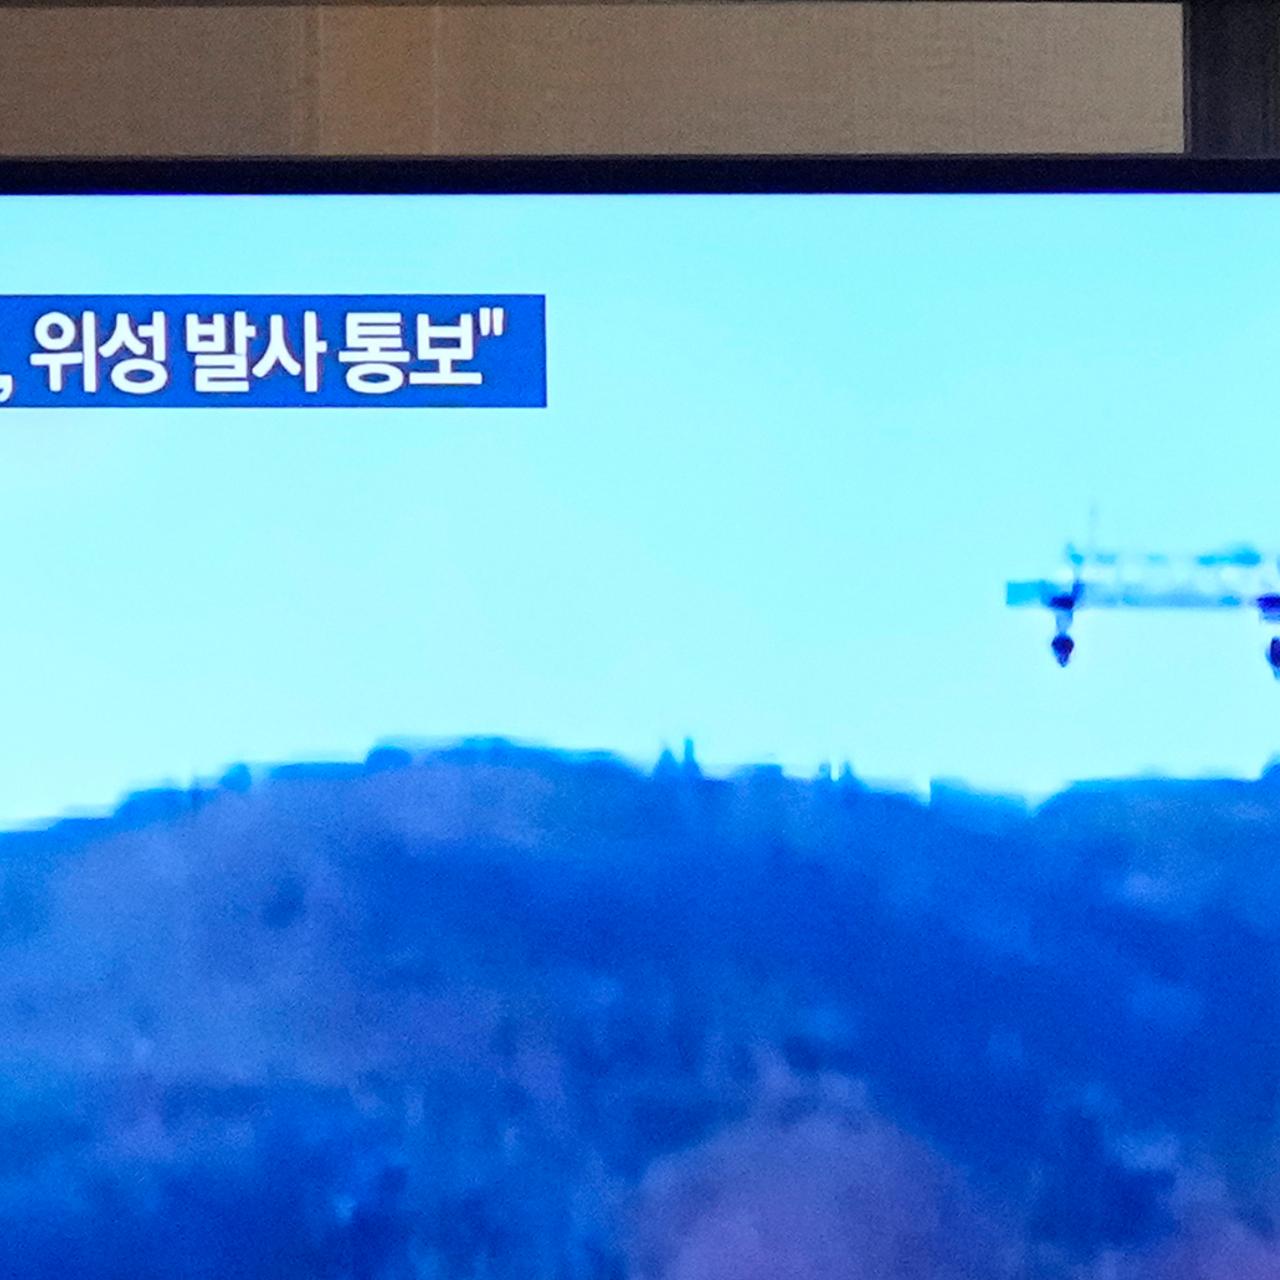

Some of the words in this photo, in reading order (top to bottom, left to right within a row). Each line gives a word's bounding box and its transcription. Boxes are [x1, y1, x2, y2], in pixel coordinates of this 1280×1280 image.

[30, 310, 169, 395] 위성
[185, 310, 328, 393] 발사
[338, 307, 505, 395] 통보"
